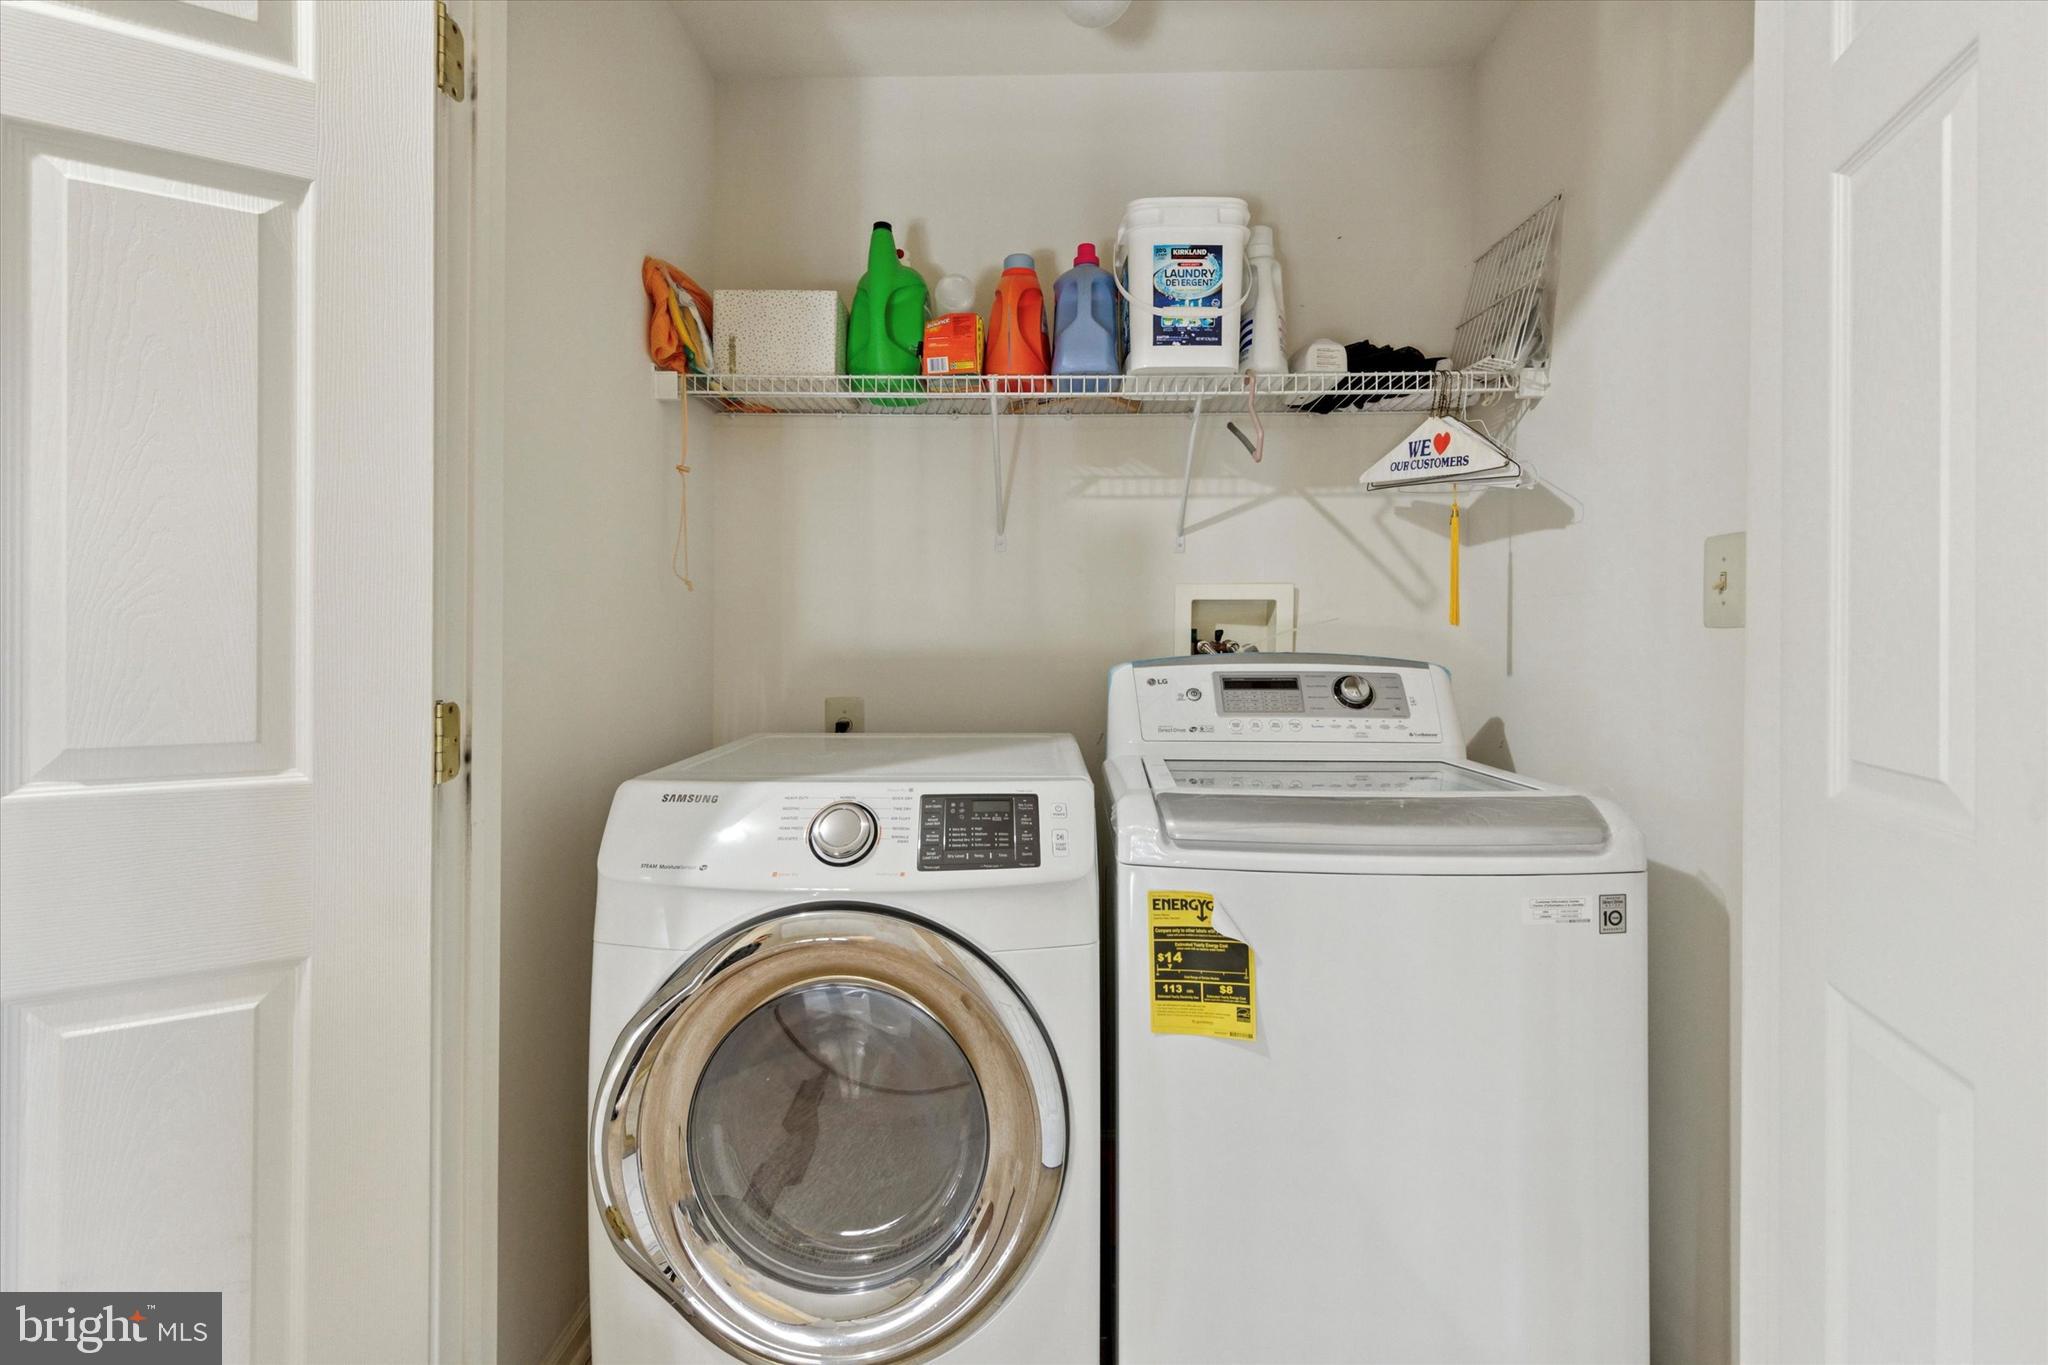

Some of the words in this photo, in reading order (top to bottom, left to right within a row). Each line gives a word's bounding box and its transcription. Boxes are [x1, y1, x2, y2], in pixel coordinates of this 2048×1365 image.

[1164, 269, 1216, 278] LAUNDRY
[1408, 439, 1432, 458] WE
[1390, 460, 1409, 472] OUR
[1410, 455, 1470, 470] CUSTOMERS
[662, 794, 719, 804] SAMSUNG
[1603, 910, 1622, 926] 10
[1157, 951, 1182, 963] $14
[1163, 984, 1182, 993] 113
[1220, 986, 1233, 994] $8
